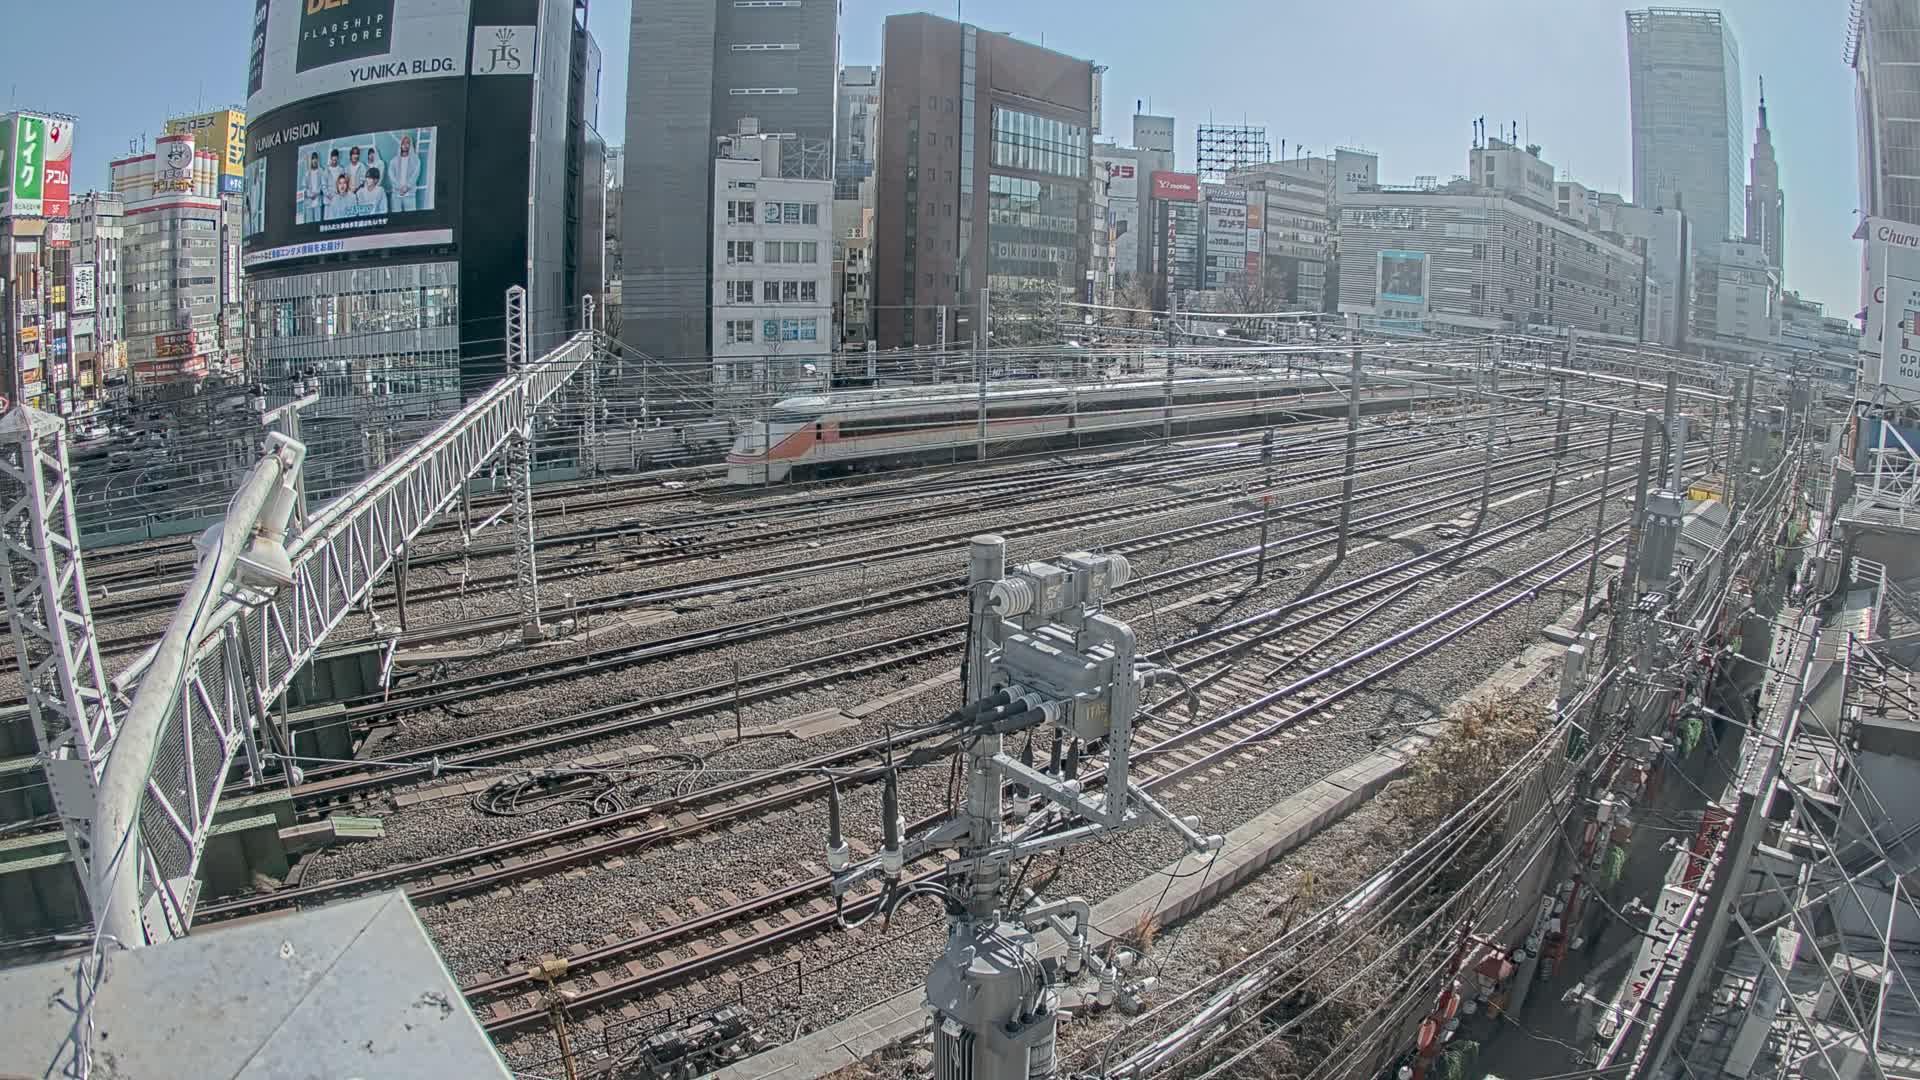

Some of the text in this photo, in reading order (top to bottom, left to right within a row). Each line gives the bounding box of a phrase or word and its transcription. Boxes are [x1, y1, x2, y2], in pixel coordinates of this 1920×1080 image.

[304, 14, 383, 40] FLAGSHIP
[329, 29, 382, 47] STORE
[350, 57, 456, 82] YUNIKA BLDG.
[255, 121, 320, 152] YUNIKA VISION
[20, 120, 37, 188] レイク
[46, 169, 68, 185] アコム
[1879, 226, 1919, 247] Churu
[1900, 353, 1920, 368] OP
